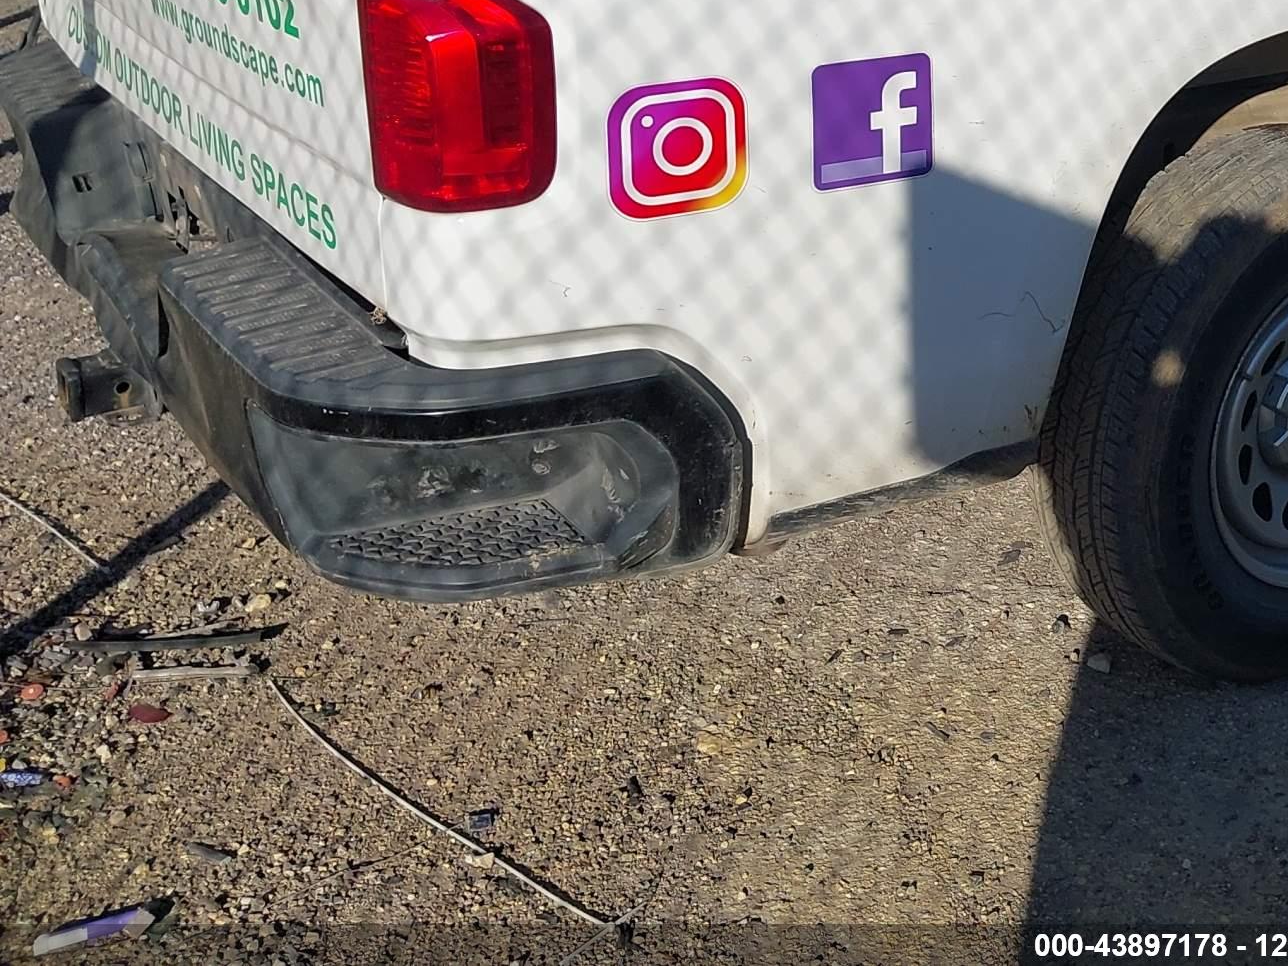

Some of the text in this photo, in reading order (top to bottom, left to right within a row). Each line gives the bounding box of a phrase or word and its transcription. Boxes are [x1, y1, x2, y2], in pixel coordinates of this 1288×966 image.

[68, 5, 338, 250] CUSOM OUTDOOR LIVING SPACES
